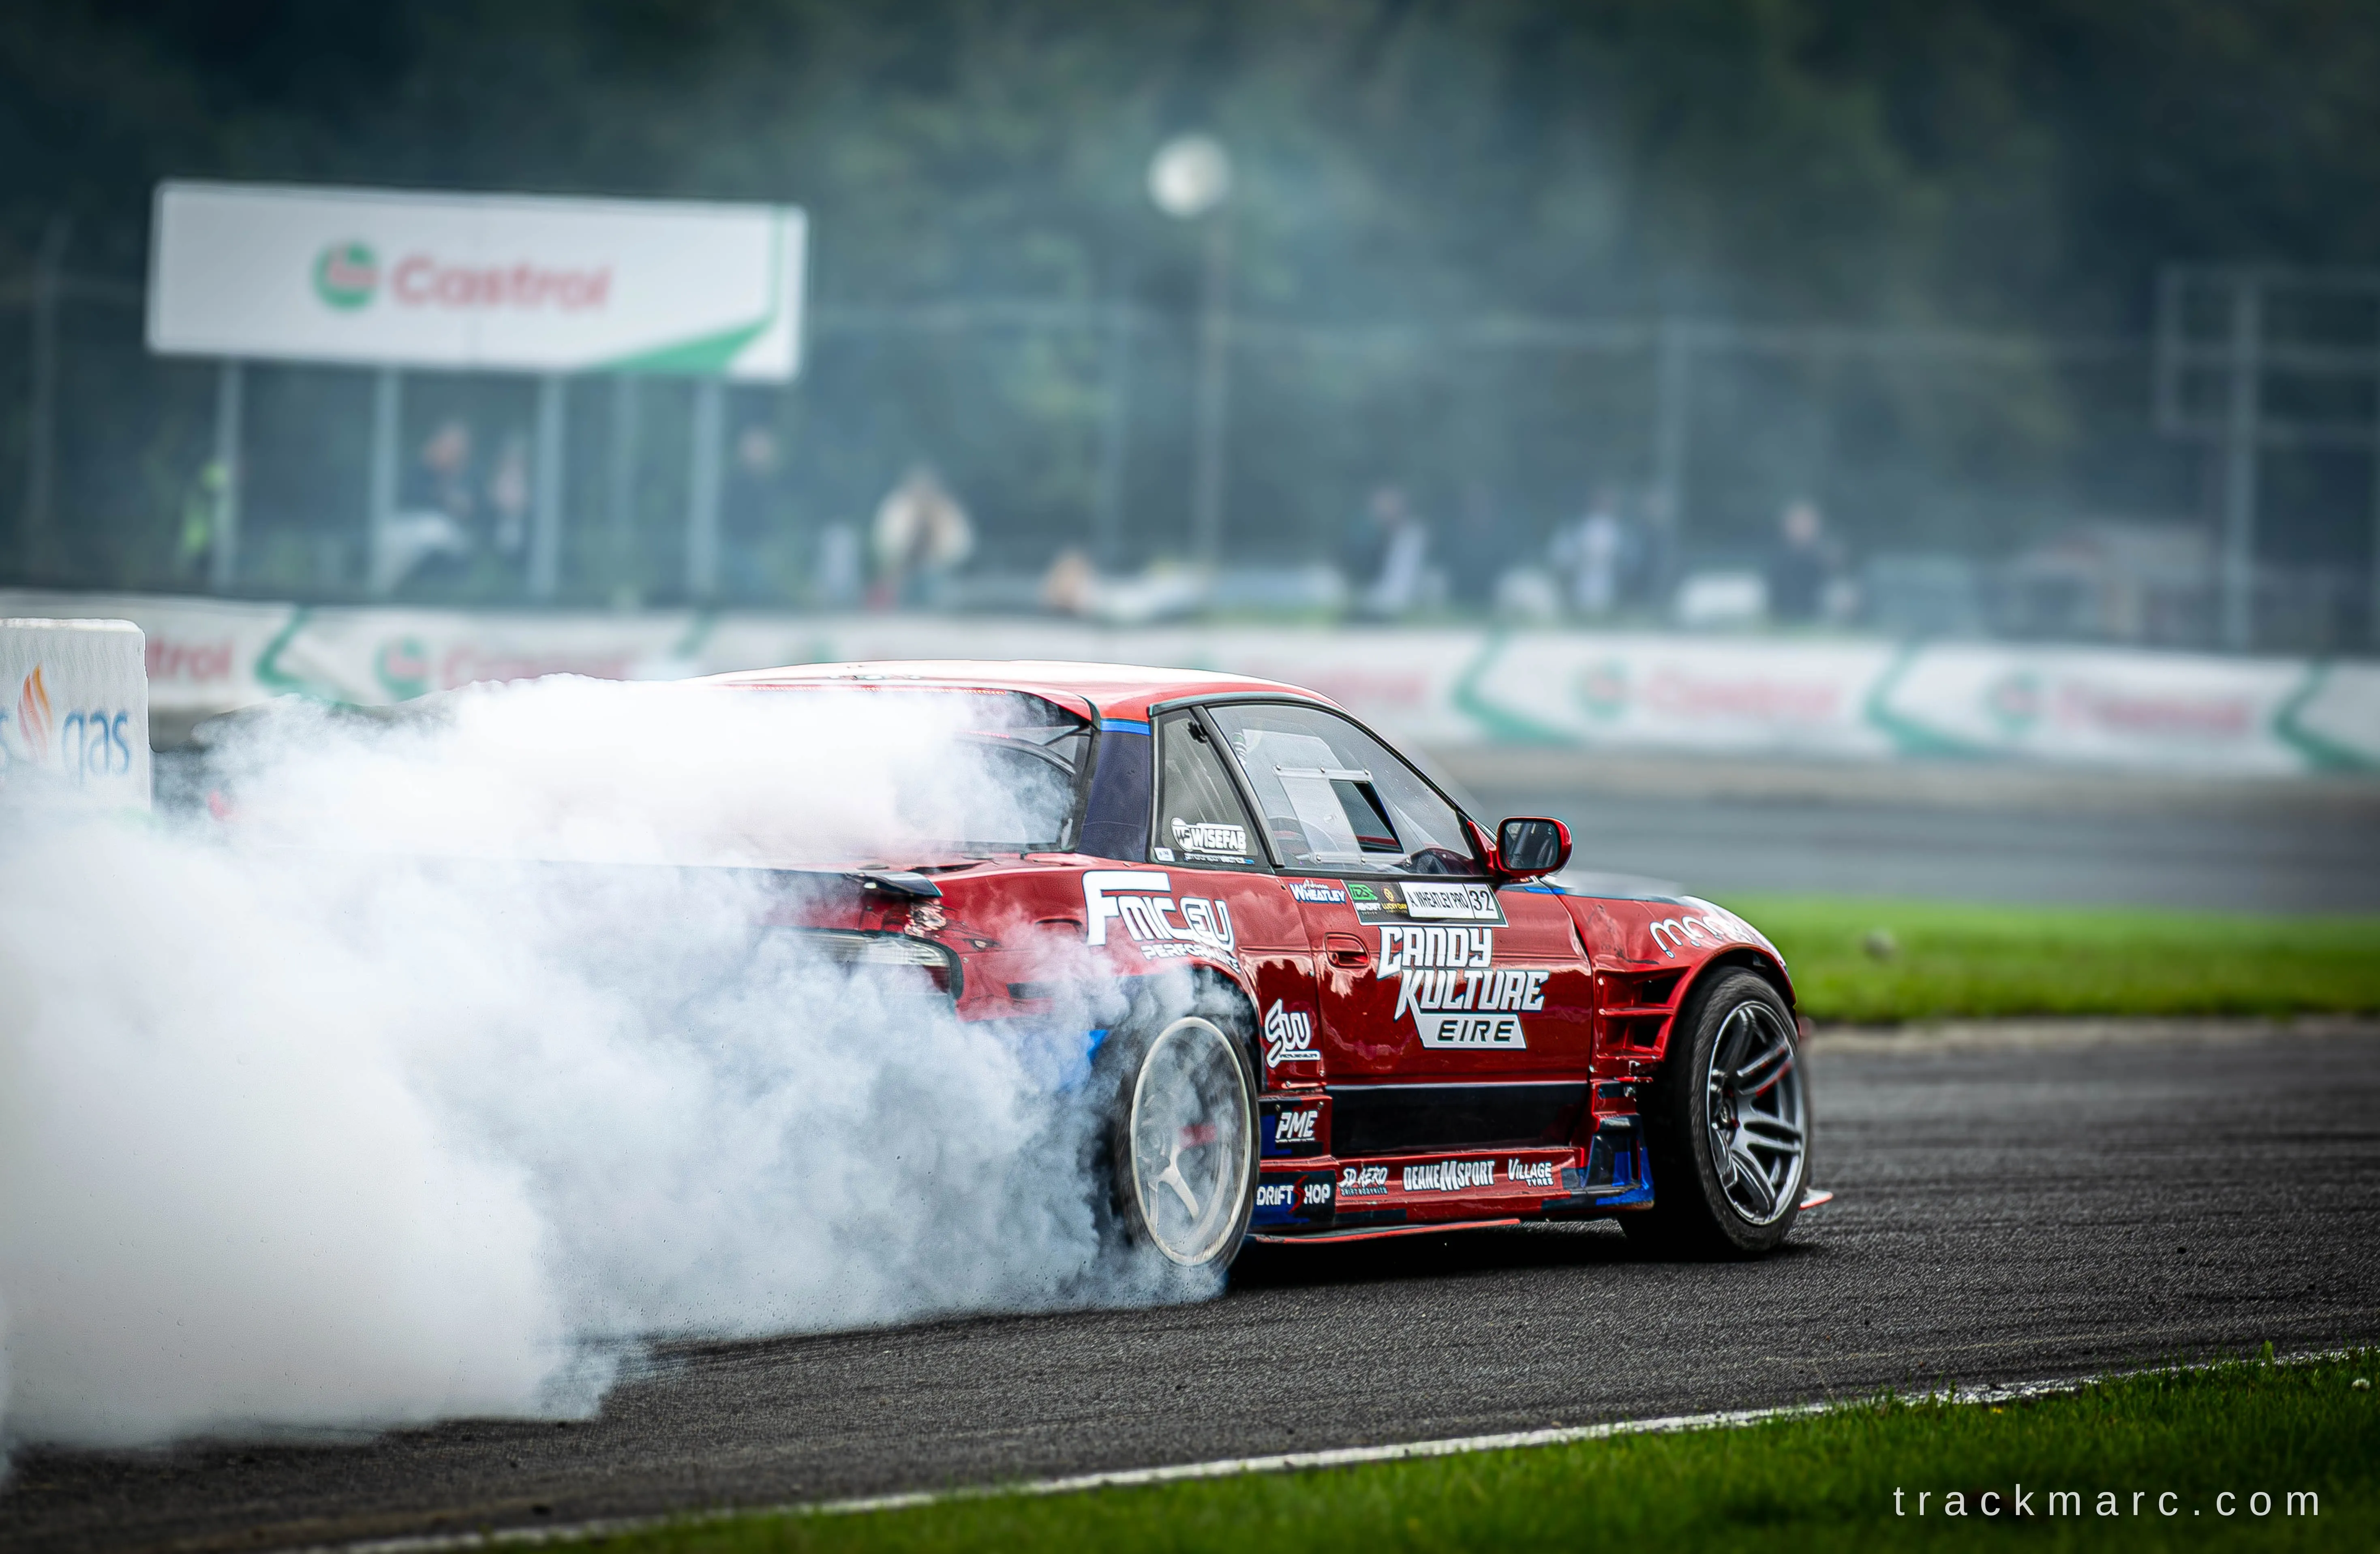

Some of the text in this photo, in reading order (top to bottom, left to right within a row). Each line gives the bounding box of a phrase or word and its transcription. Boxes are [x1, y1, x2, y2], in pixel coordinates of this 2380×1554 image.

[394, 254, 611, 311] Castrol
[1191, 828, 1246, 850] WISEFAB
[1413, 891, 1453, 908] WHEATLEY
[1450, 892, 1470, 909] PRO
[1469, 890, 1494, 912] 32
[1376, 926, 1492, 980] CANDY
[1393, 969, 1550, 1023] KULTURE
[1438, 1020, 1515, 1043] EIRE
[1276, 1111, 1318, 1139] PME
[1508, 1159, 1552, 1180] VILLAGE
